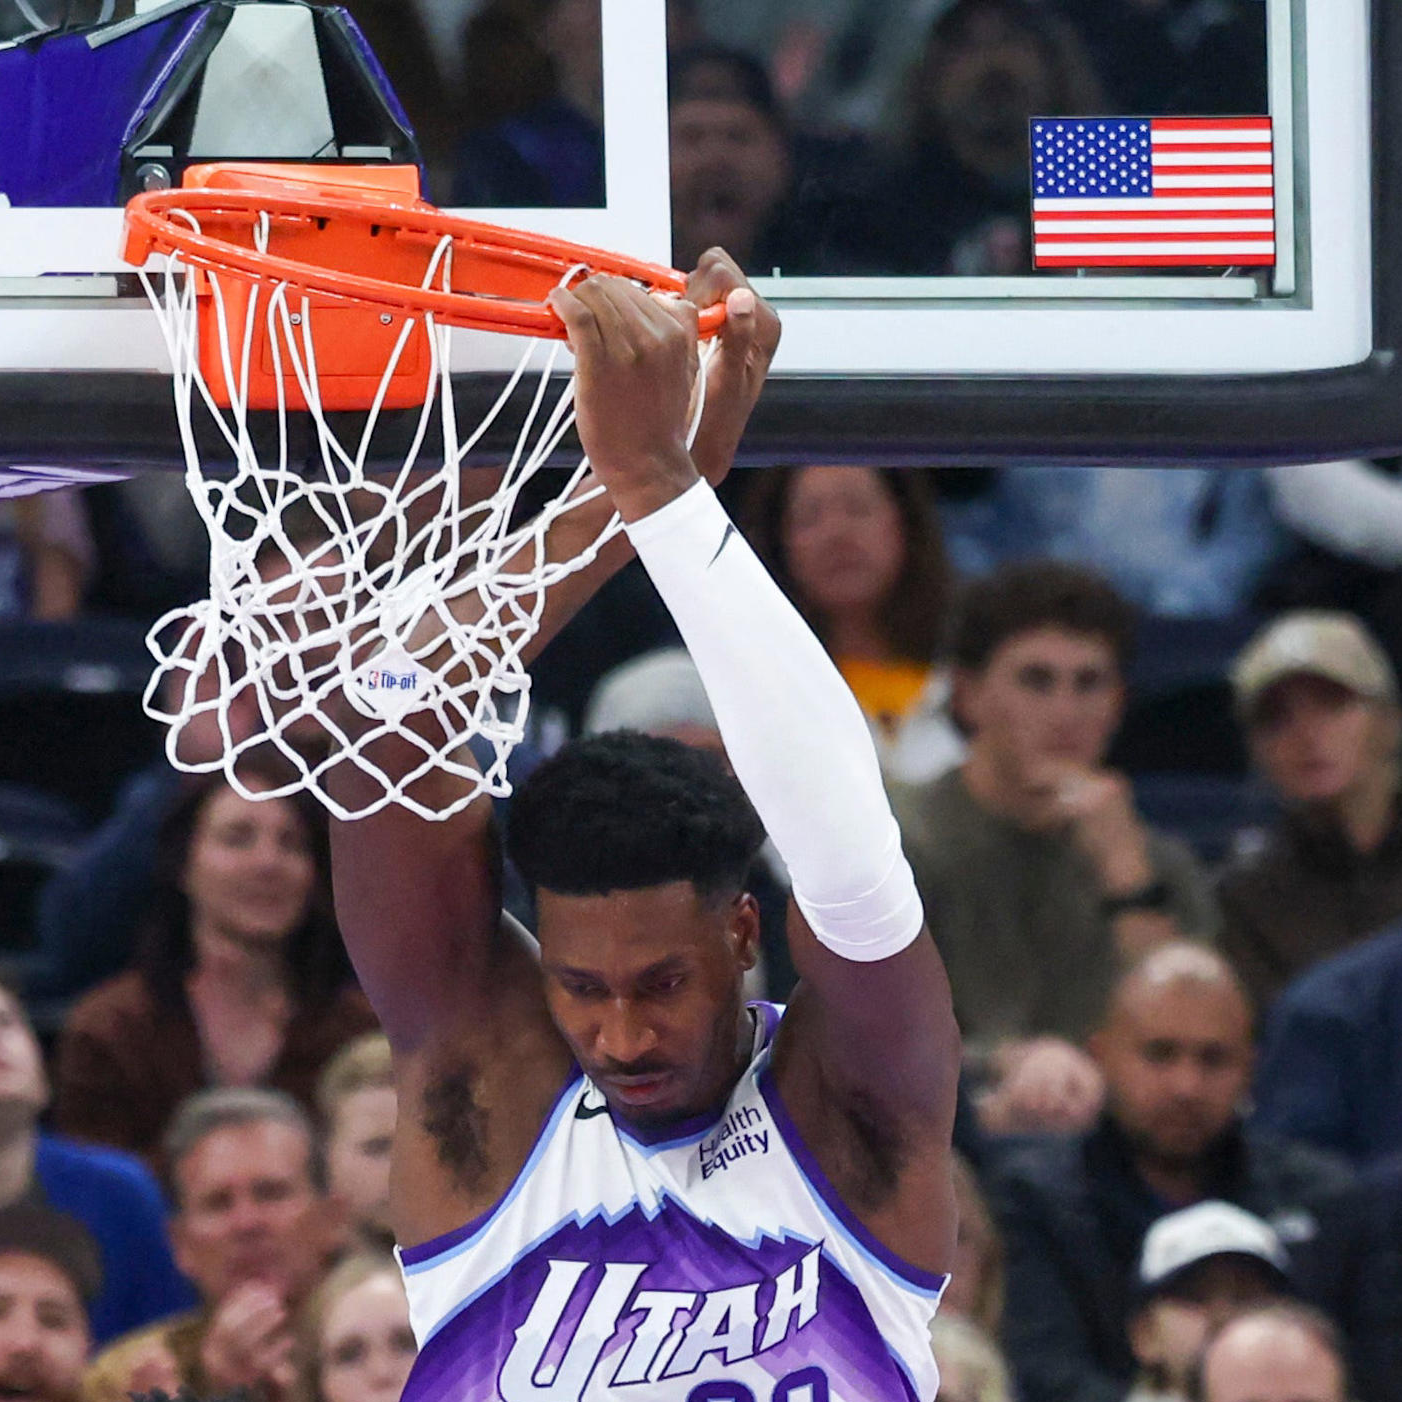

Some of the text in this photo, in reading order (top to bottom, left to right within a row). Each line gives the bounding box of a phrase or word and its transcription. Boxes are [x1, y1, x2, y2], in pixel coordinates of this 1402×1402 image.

[381, 670, 417, 690] TIP-OFF
[699, 1106, 762, 1162] Halth
[701, 1129, 768, 1181] Equity
